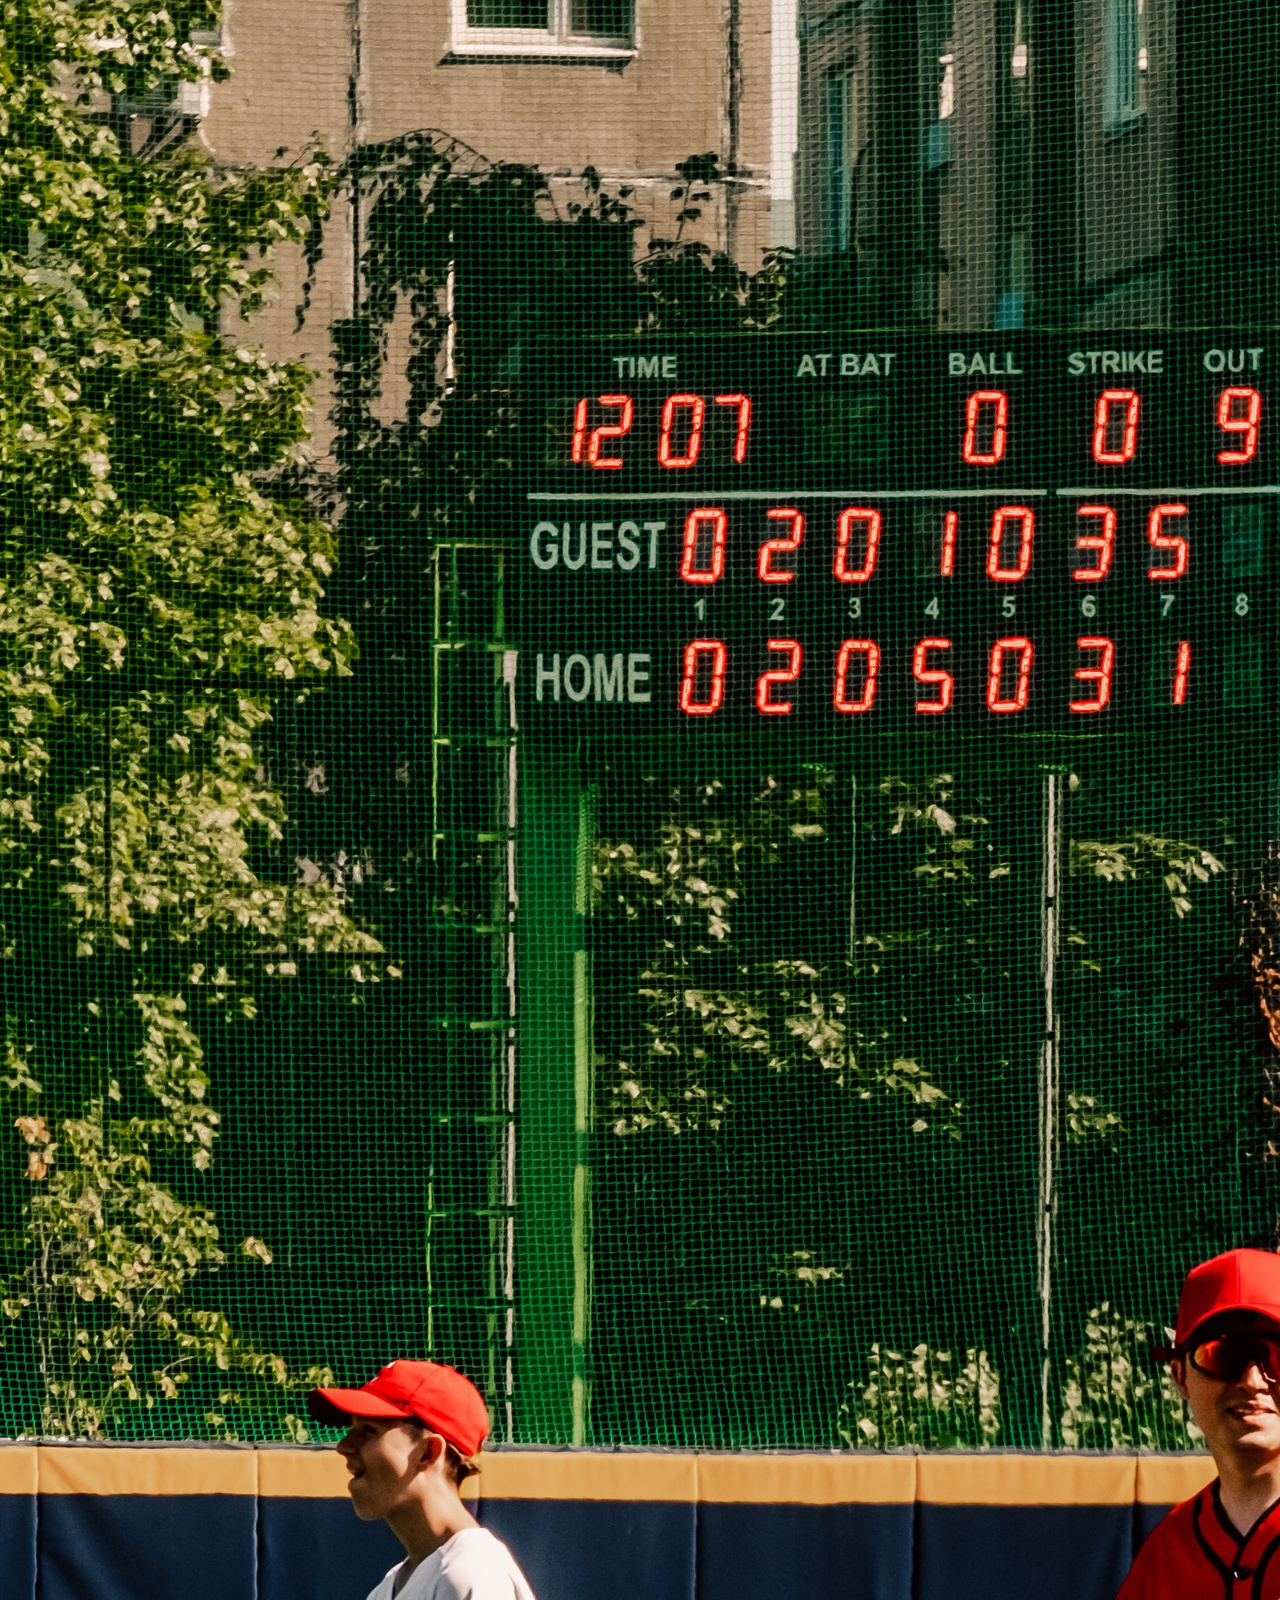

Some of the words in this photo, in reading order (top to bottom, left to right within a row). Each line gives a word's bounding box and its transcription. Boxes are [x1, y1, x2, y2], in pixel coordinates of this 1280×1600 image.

[613, 355, 677, 378] TIME
[797, 354, 831, 377] AT
[841, 353, 894, 376] BAT
[948, 352, 1021, 375] BALL
[1068, 350, 1163, 375] STRIKE
[1204, 348, 1261, 373] OUT
[963, 390, 1008, 465] 0
[1092, 389, 1140, 464] 0
[1217, 387, 1262, 464] 9
[530, 520, 666, 570] GUEST
[680, 508, 728, 584] 0
[757, 508, 805, 583] 2
[832, 507, 881, 582] 0
[941, 511, 957, 576] 1
[986, 506, 1035, 581] 0
[1073, 504, 1116, 581] 3
[1148, 503, 1189, 580] 5
[695, 599, 704, 620] 1
[770, 598, 785, 621] 2
[848, 597, 861, 619] 3
[924, 597, 940, 619] 4
[1002, 596, 1016, 618] 5
[1081, 594, 1096, 618] 6
[1160, 594, 1175, 616] 7
[1235, 593, 1249, 616] 8
[536, 653, 651, 703] HOME
[679, 639, 727, 715] 0
[756, 639, 802, 714] 2
[833, 639, 880, 713] 0
[913, 638, 954, 714] 5
[986, 636, 1034, 712] 0
[1070, 636, 1114, 713] 3
[1174, 641, 1190, 704] 1
